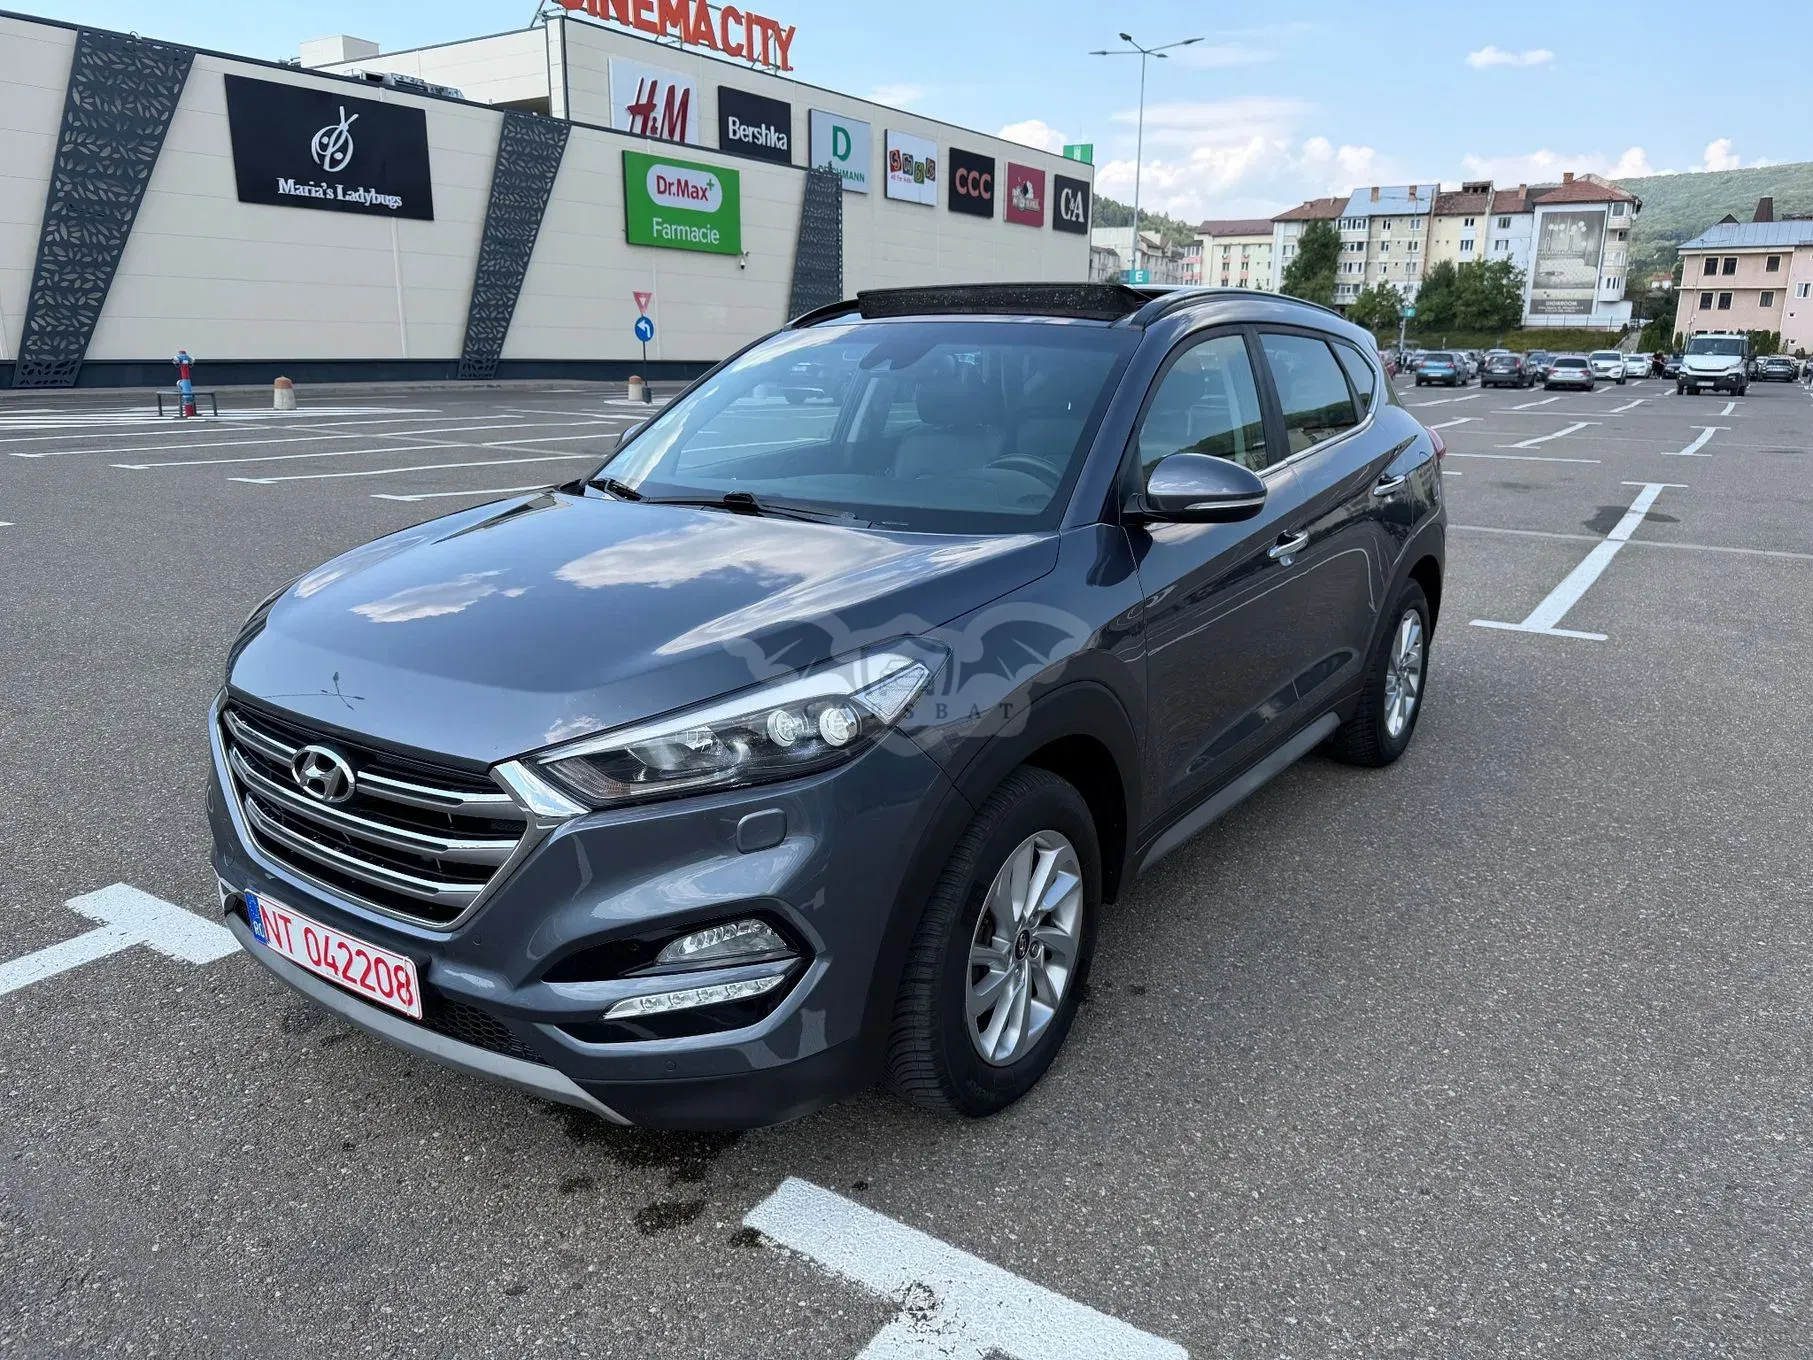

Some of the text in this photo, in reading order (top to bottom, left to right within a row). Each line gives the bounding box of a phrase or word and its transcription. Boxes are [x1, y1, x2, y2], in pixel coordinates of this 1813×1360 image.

[625, 77, 690, 143] H&M
[728, 116, 788, 150] Bershka
[832, 125, 851, 161] D
[276, 177, 403, 209] Maria's Ladybugs
[955, 167, 991, 200] CCC
[1060, 188, 1085, 223] C&A
[652, 217, 720, 244] Farmacie
[1135, 270, 1143, 282] E
[259, 903, 413, 1007] NT 042208
